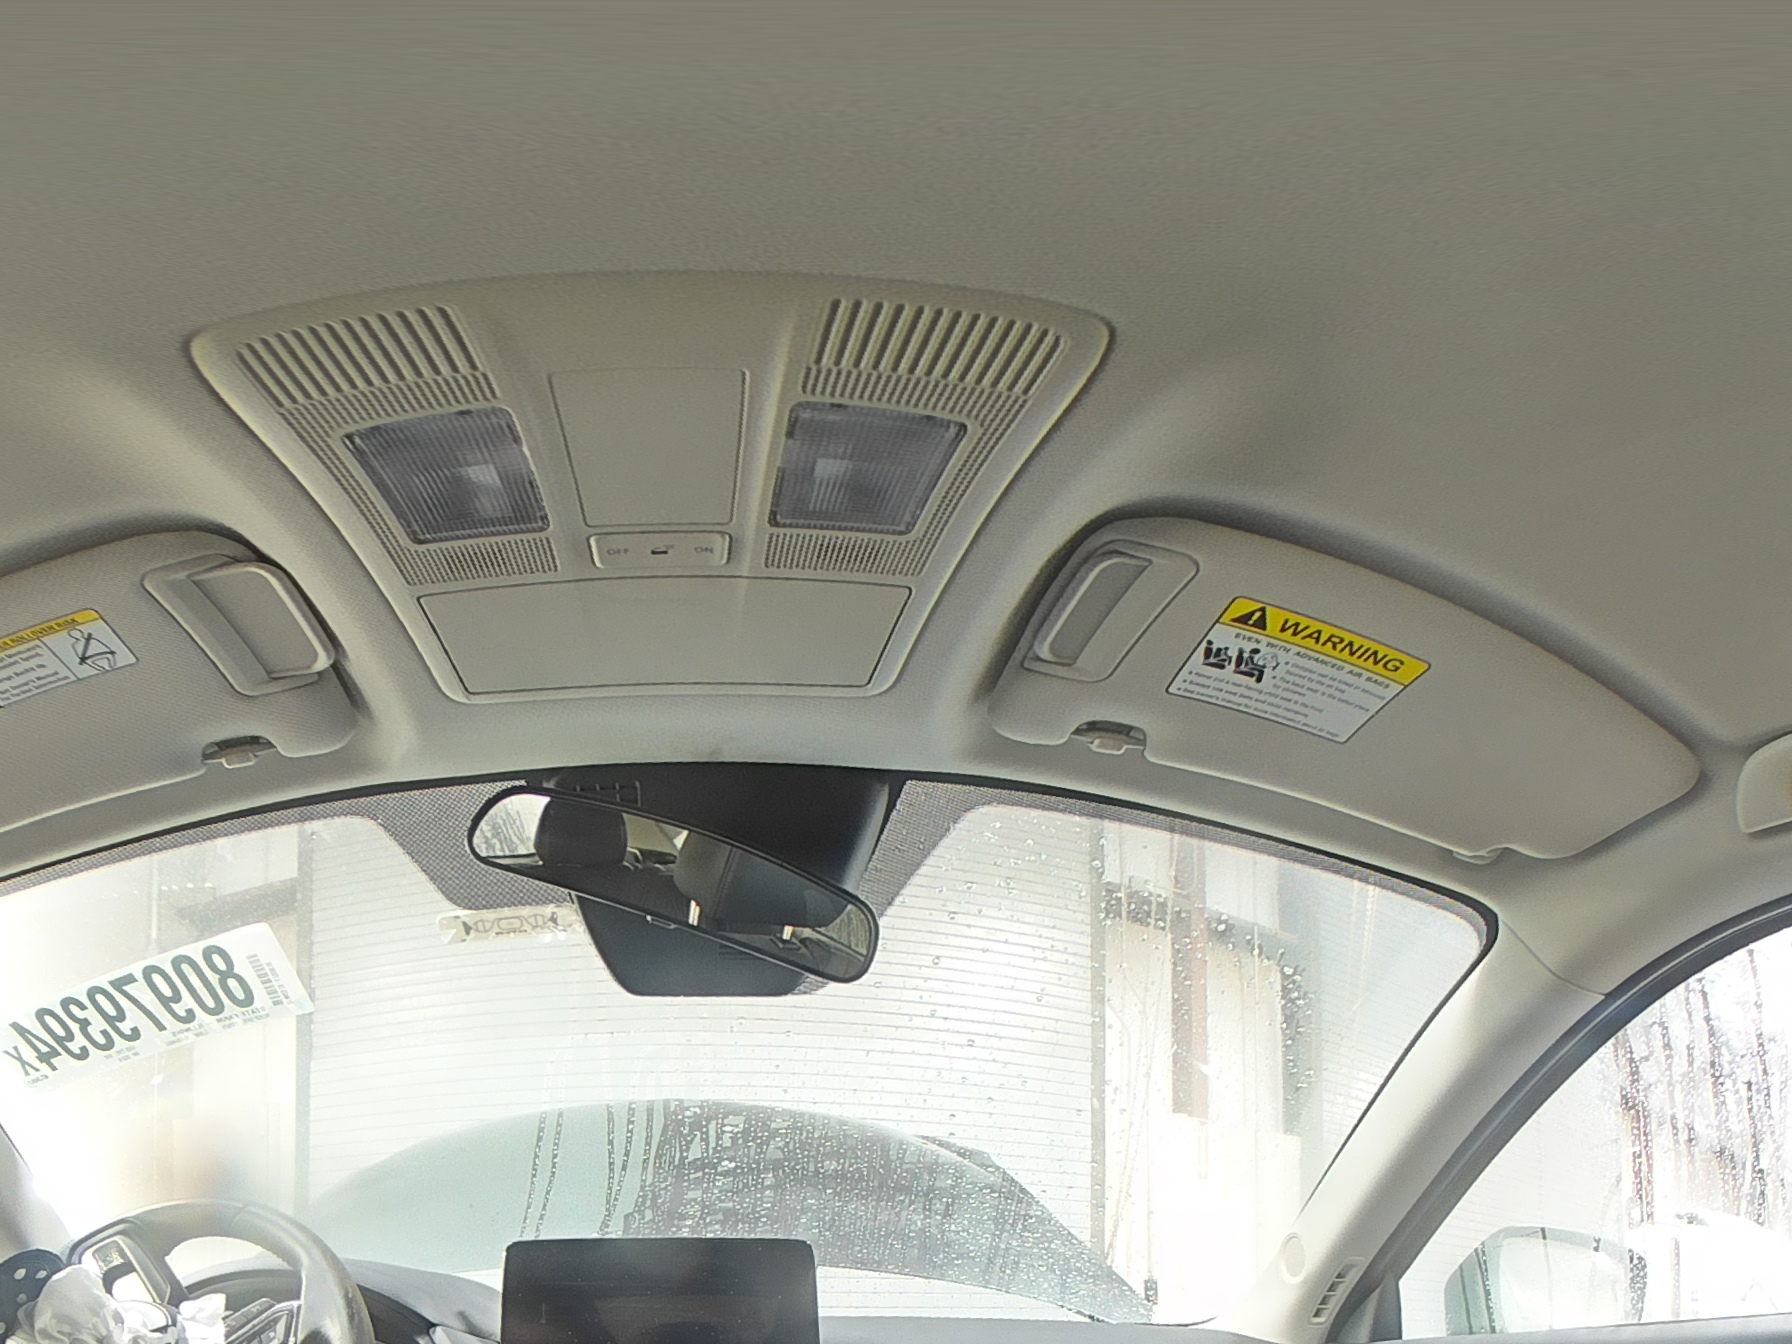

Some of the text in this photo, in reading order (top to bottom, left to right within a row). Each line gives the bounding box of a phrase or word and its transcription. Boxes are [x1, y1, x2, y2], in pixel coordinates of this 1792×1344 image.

[693, 545, 715, 555] ON
[1234, 632, 1261, 645] EVEN
[1265, 641, 1291, 655] WITH
[1293, 650, 1346, 671] ADVANCED
[1345, 668, 1364, 680] AIR
[1279, 617, 1406, 674] WARNING
